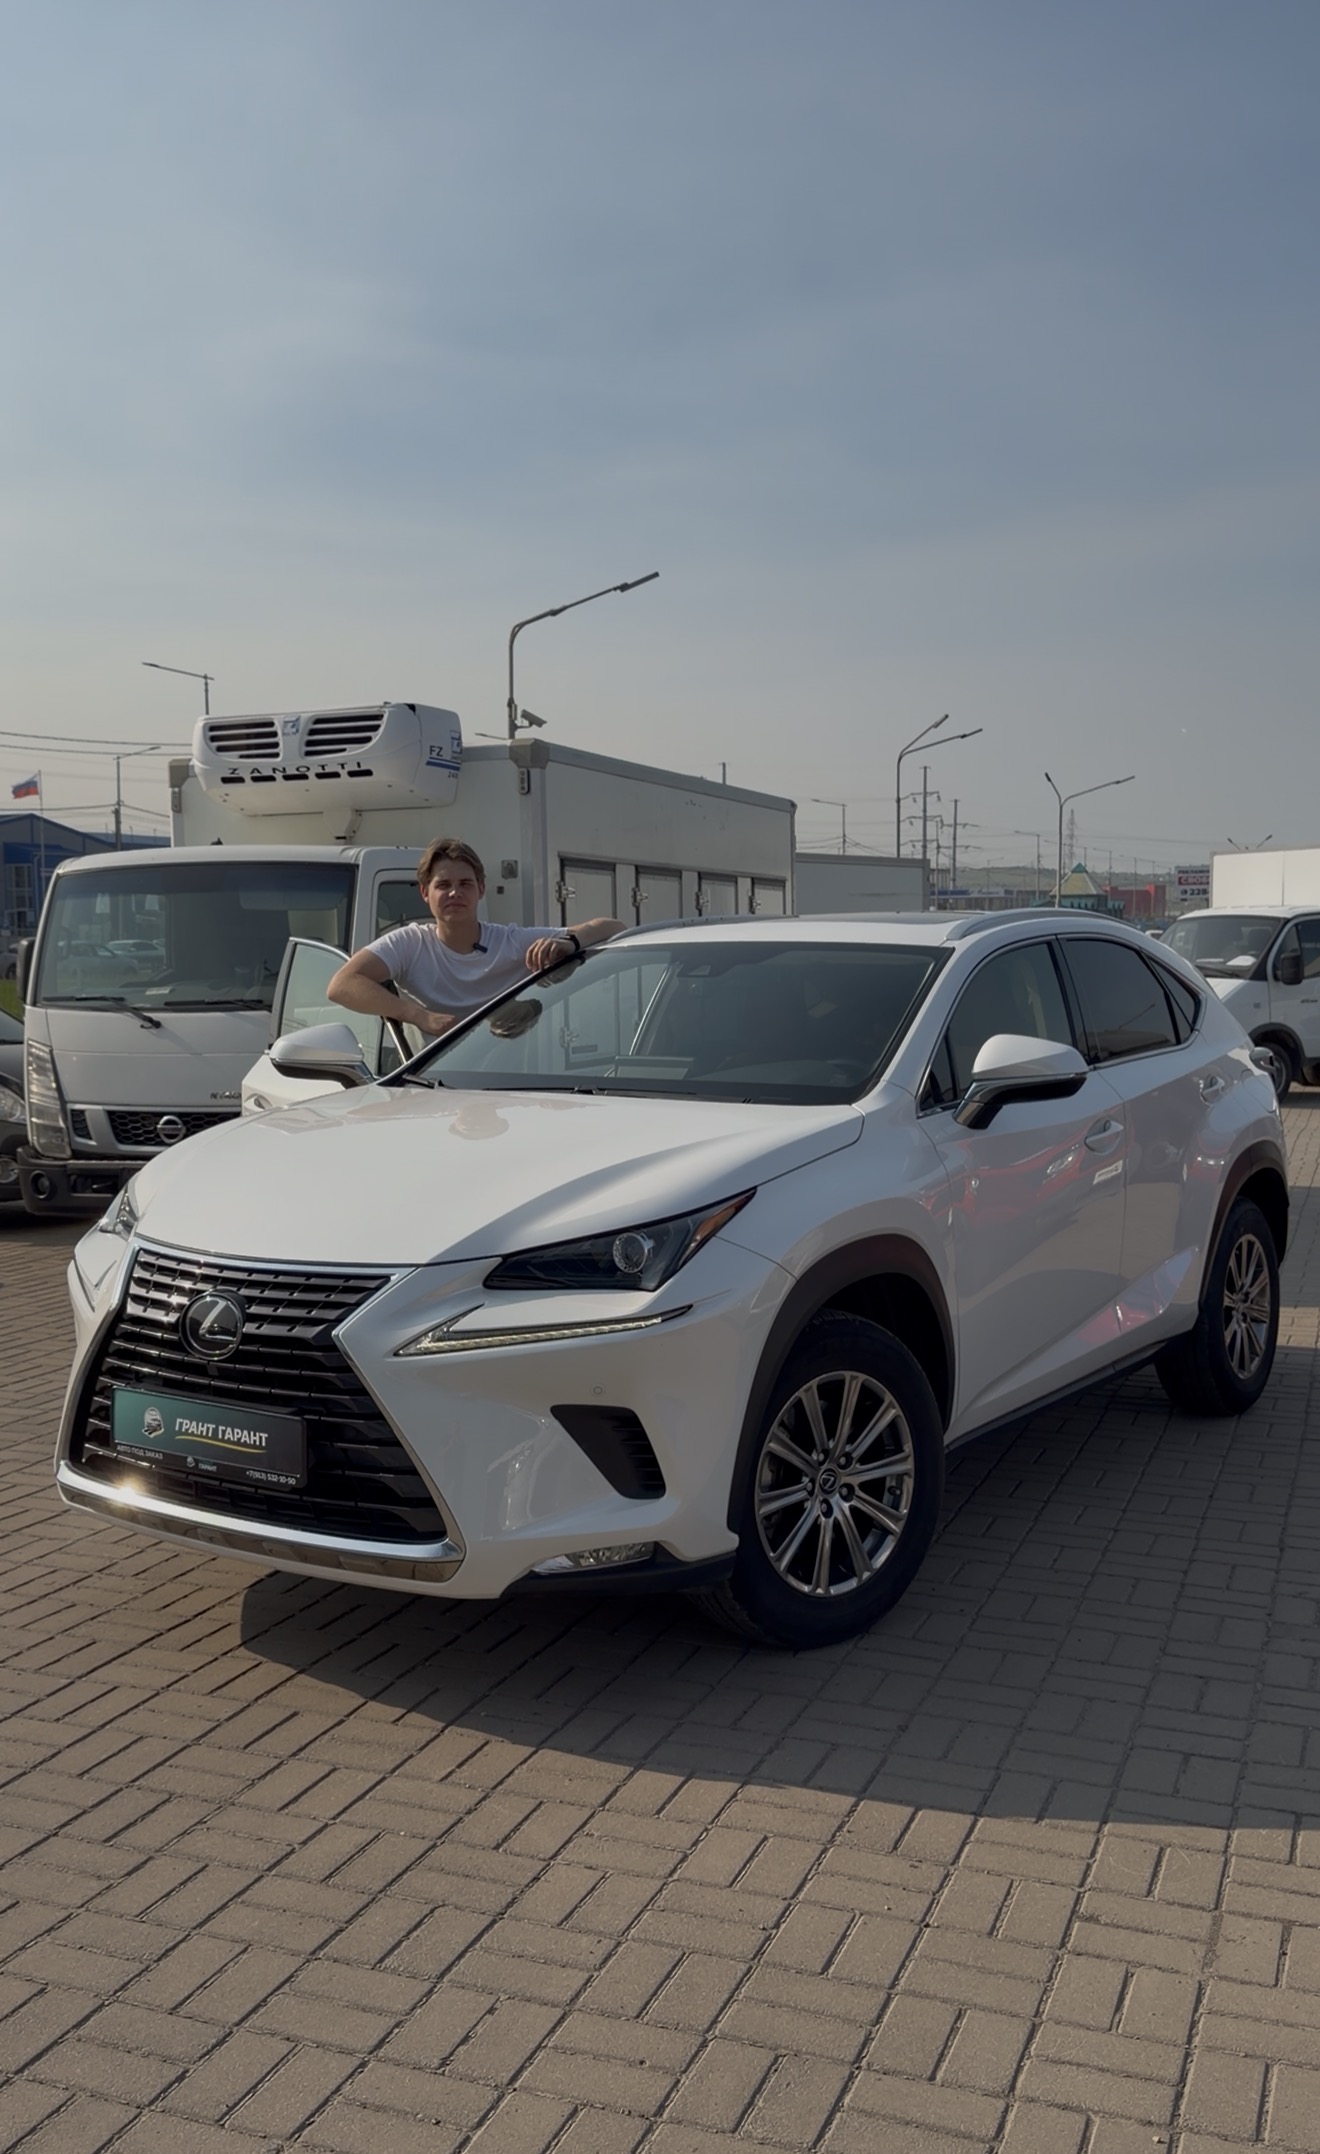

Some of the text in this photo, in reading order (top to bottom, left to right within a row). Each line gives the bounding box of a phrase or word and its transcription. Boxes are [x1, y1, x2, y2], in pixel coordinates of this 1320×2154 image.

[429, 744, 444, 757] FZ
[227, 760, 363, 776] ZANOTTI
[175, 1417, 269, 1447] ГРАНТ ГАРАНТ
[131, 1447, 144, 1456] ПОД
[145, 1449, 163, 1460] ЗАКАЗ
